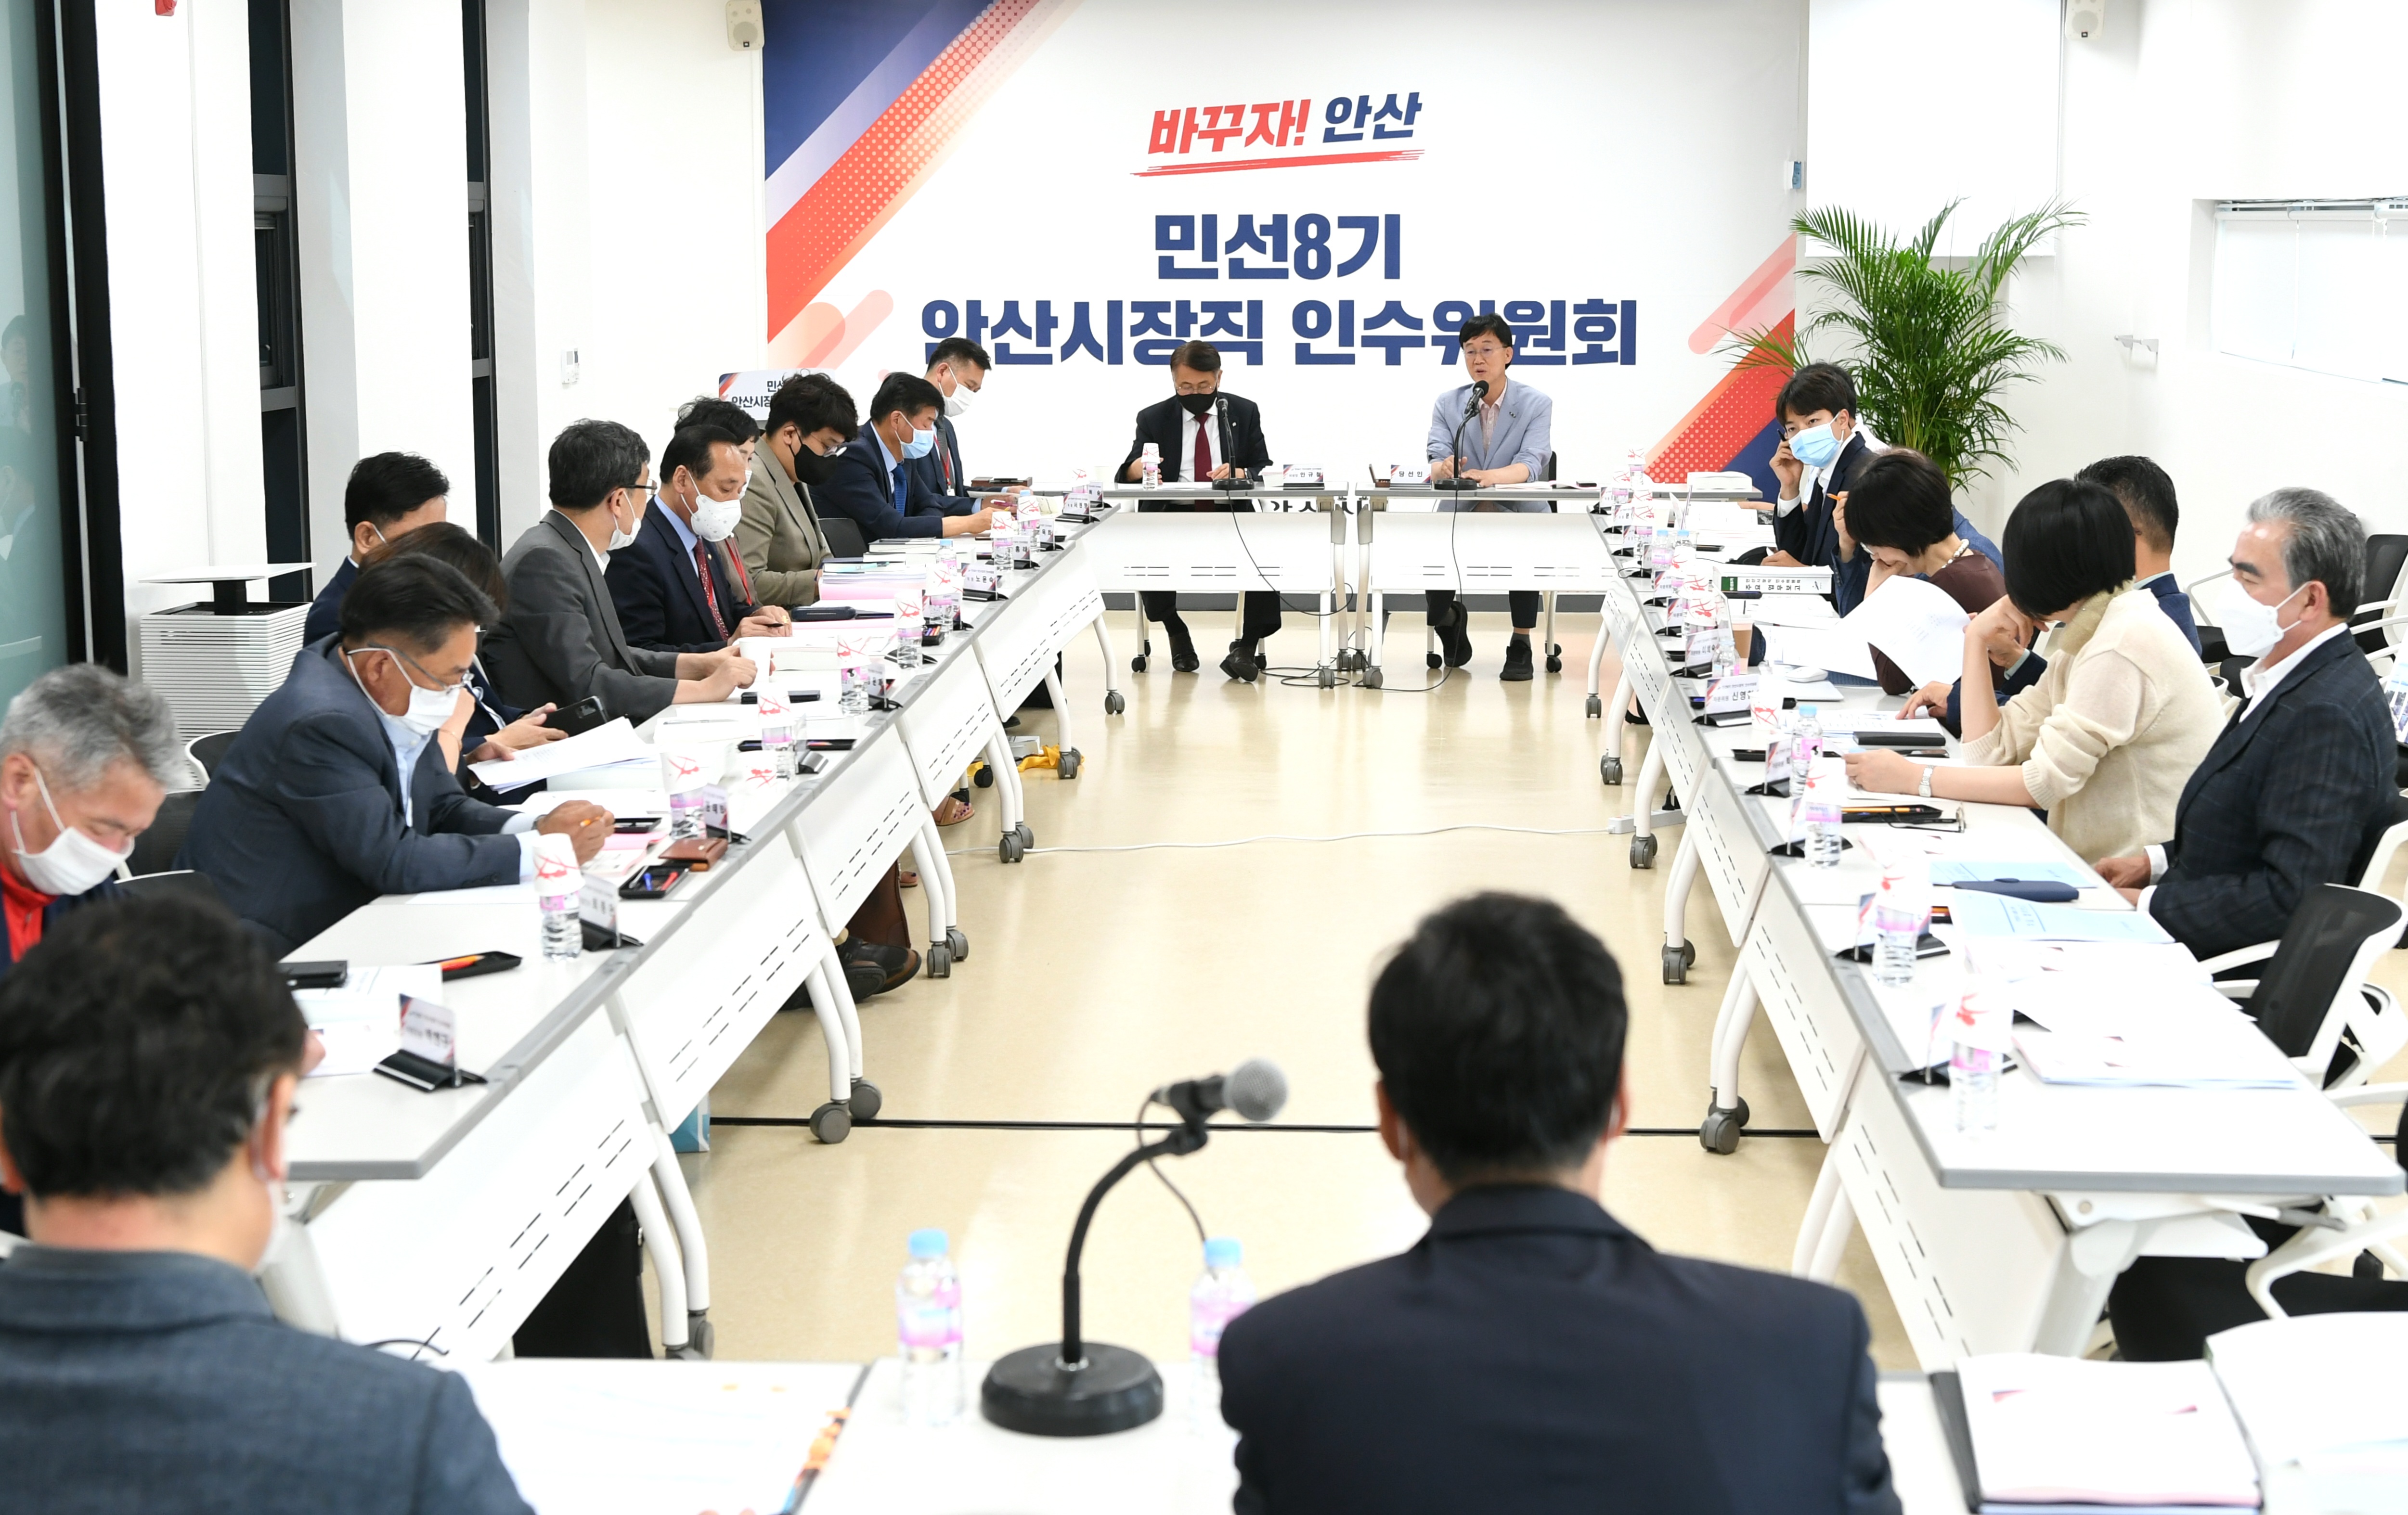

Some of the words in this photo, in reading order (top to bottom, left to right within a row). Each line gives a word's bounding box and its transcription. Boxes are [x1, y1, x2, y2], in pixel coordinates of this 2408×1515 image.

[1148, 99, 1311, 154] 바꾸자!
[1322, 92, 1423, 143] 안산
[1155, 213, 1400, 280] 민선8기
[921, 299, 1263, 365] 안산시장직
